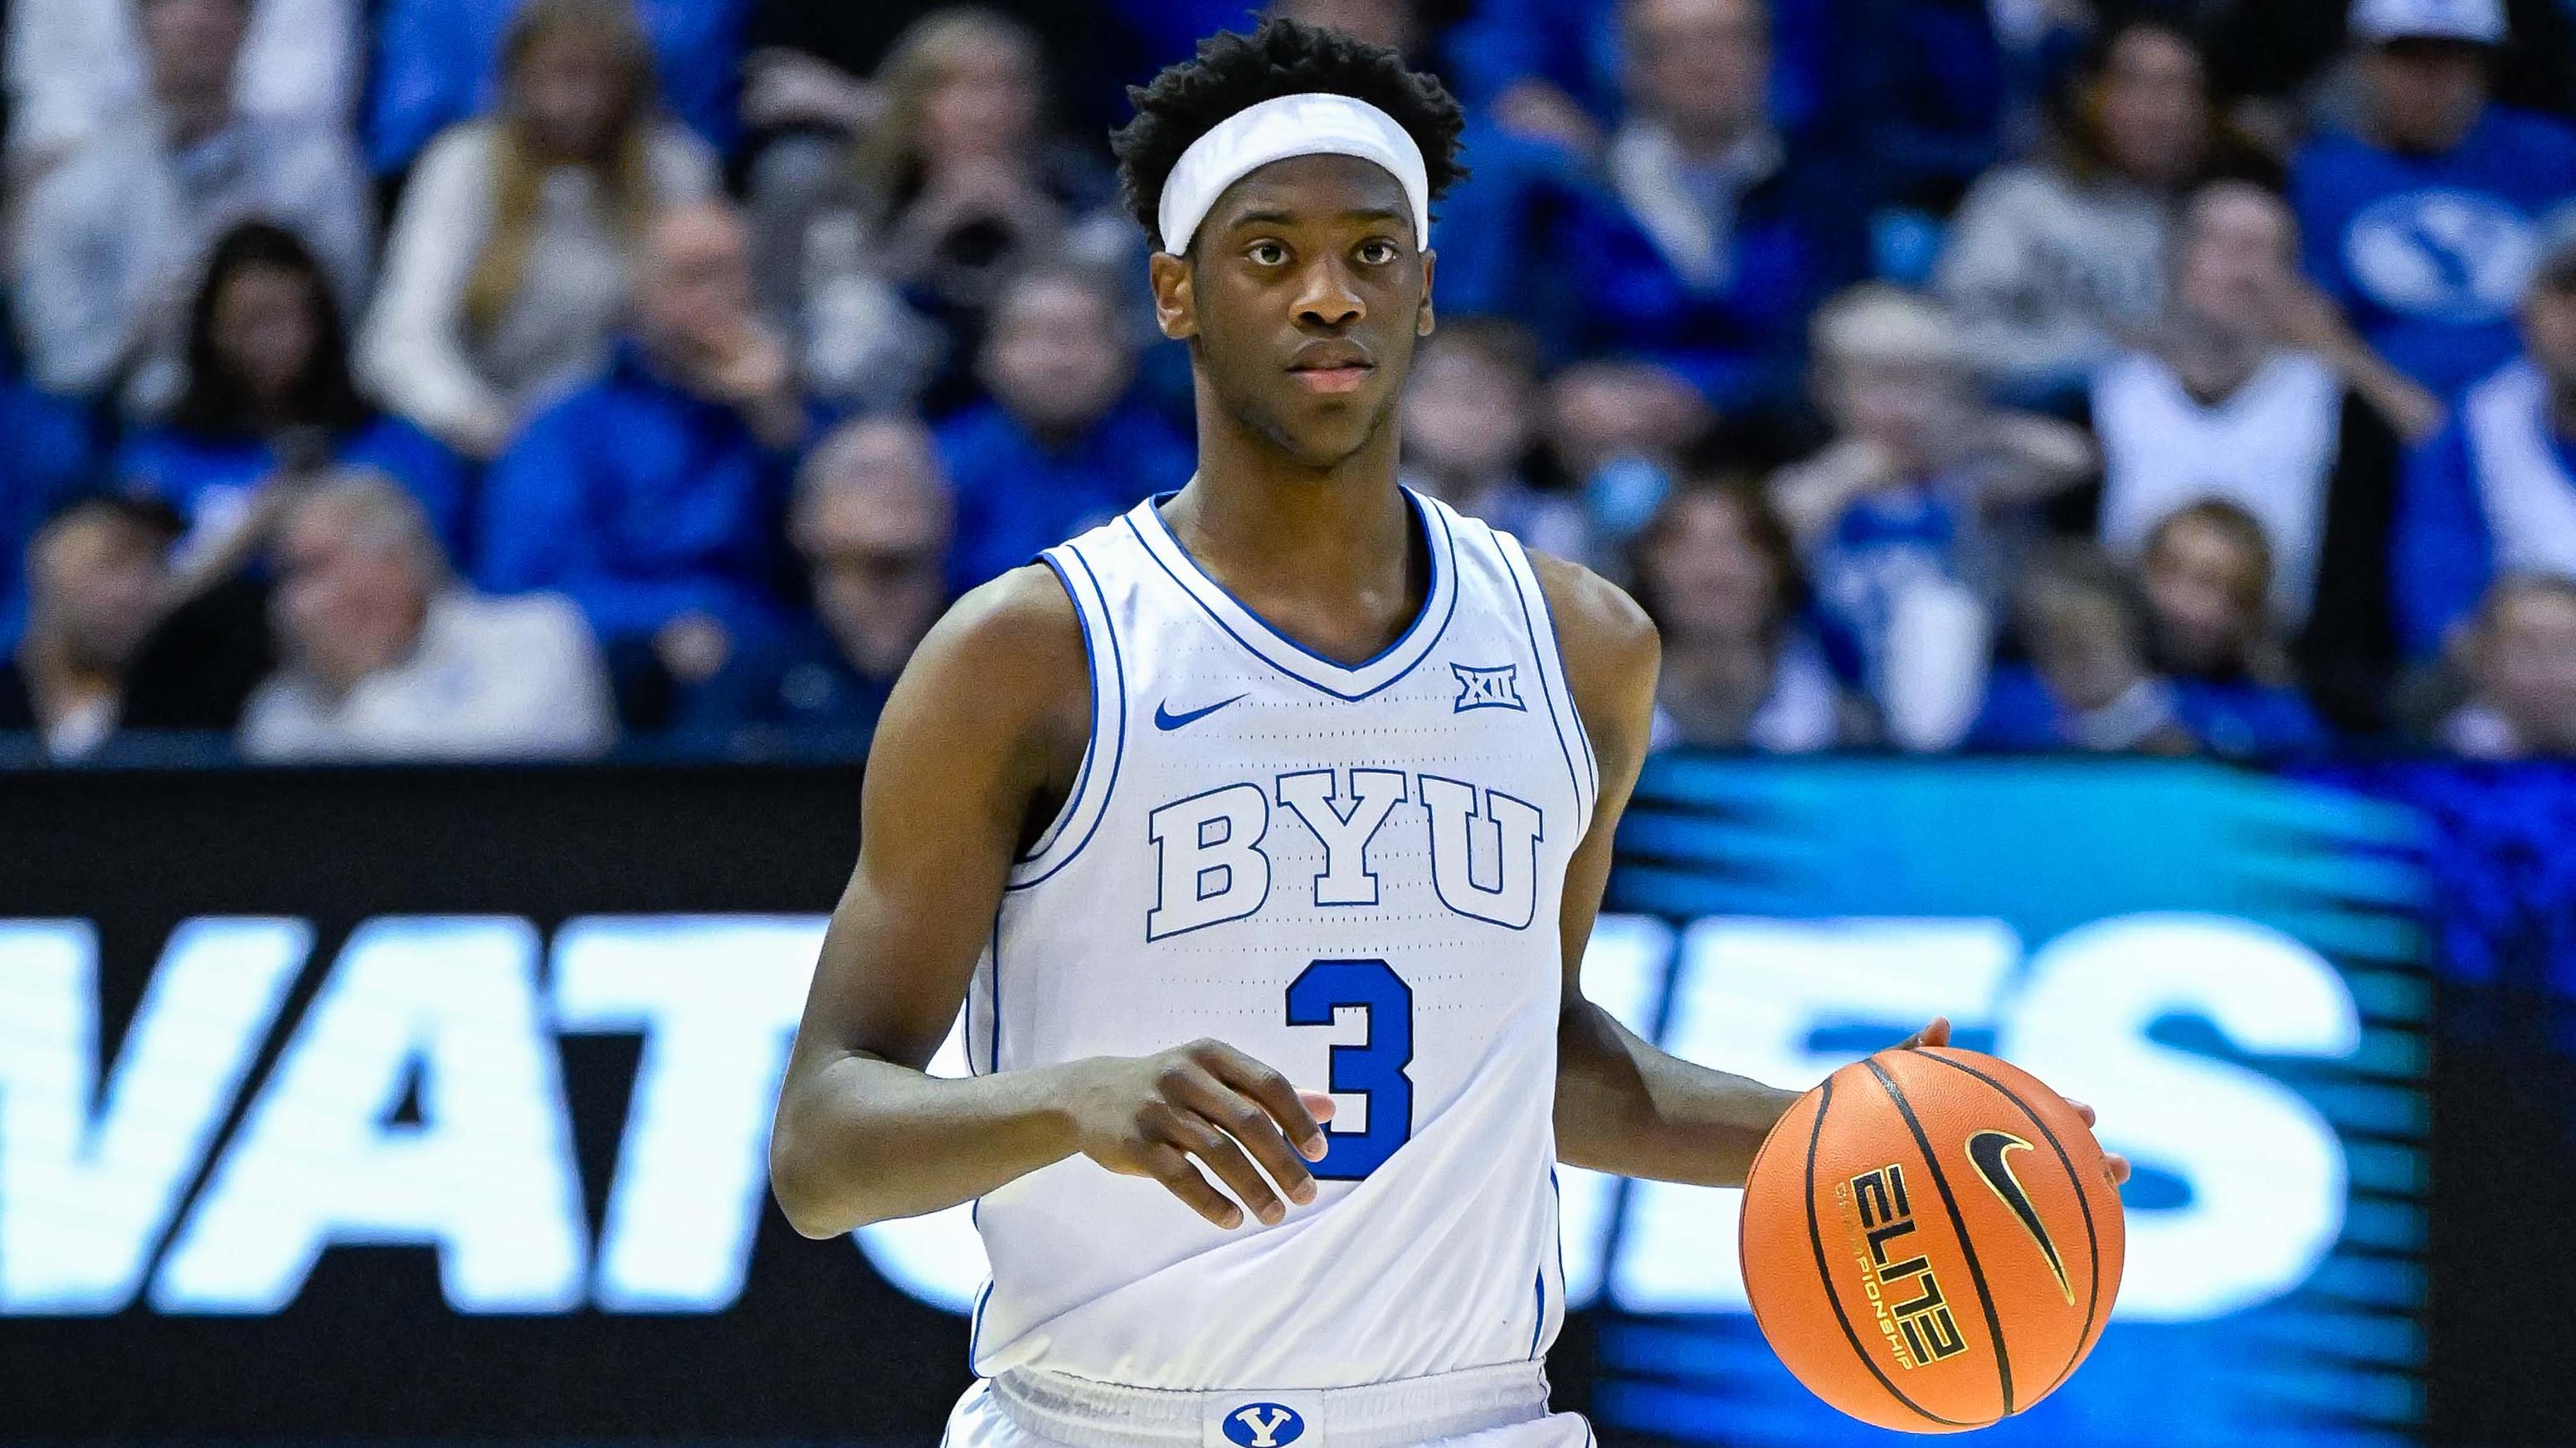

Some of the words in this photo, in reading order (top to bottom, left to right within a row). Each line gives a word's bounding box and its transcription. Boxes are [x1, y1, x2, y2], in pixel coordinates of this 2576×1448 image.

[1449, 661, 1528, 714] XII
[1147, 767, 1543, 943] BYU
[1284, 958, 1414, 1182] 3
[1835, 1181, 1913, 1372] CPIONSHIP
[1849, 1163, 1970, 1368] ELITE
[1234, 1407, 1293, 1447] Y
